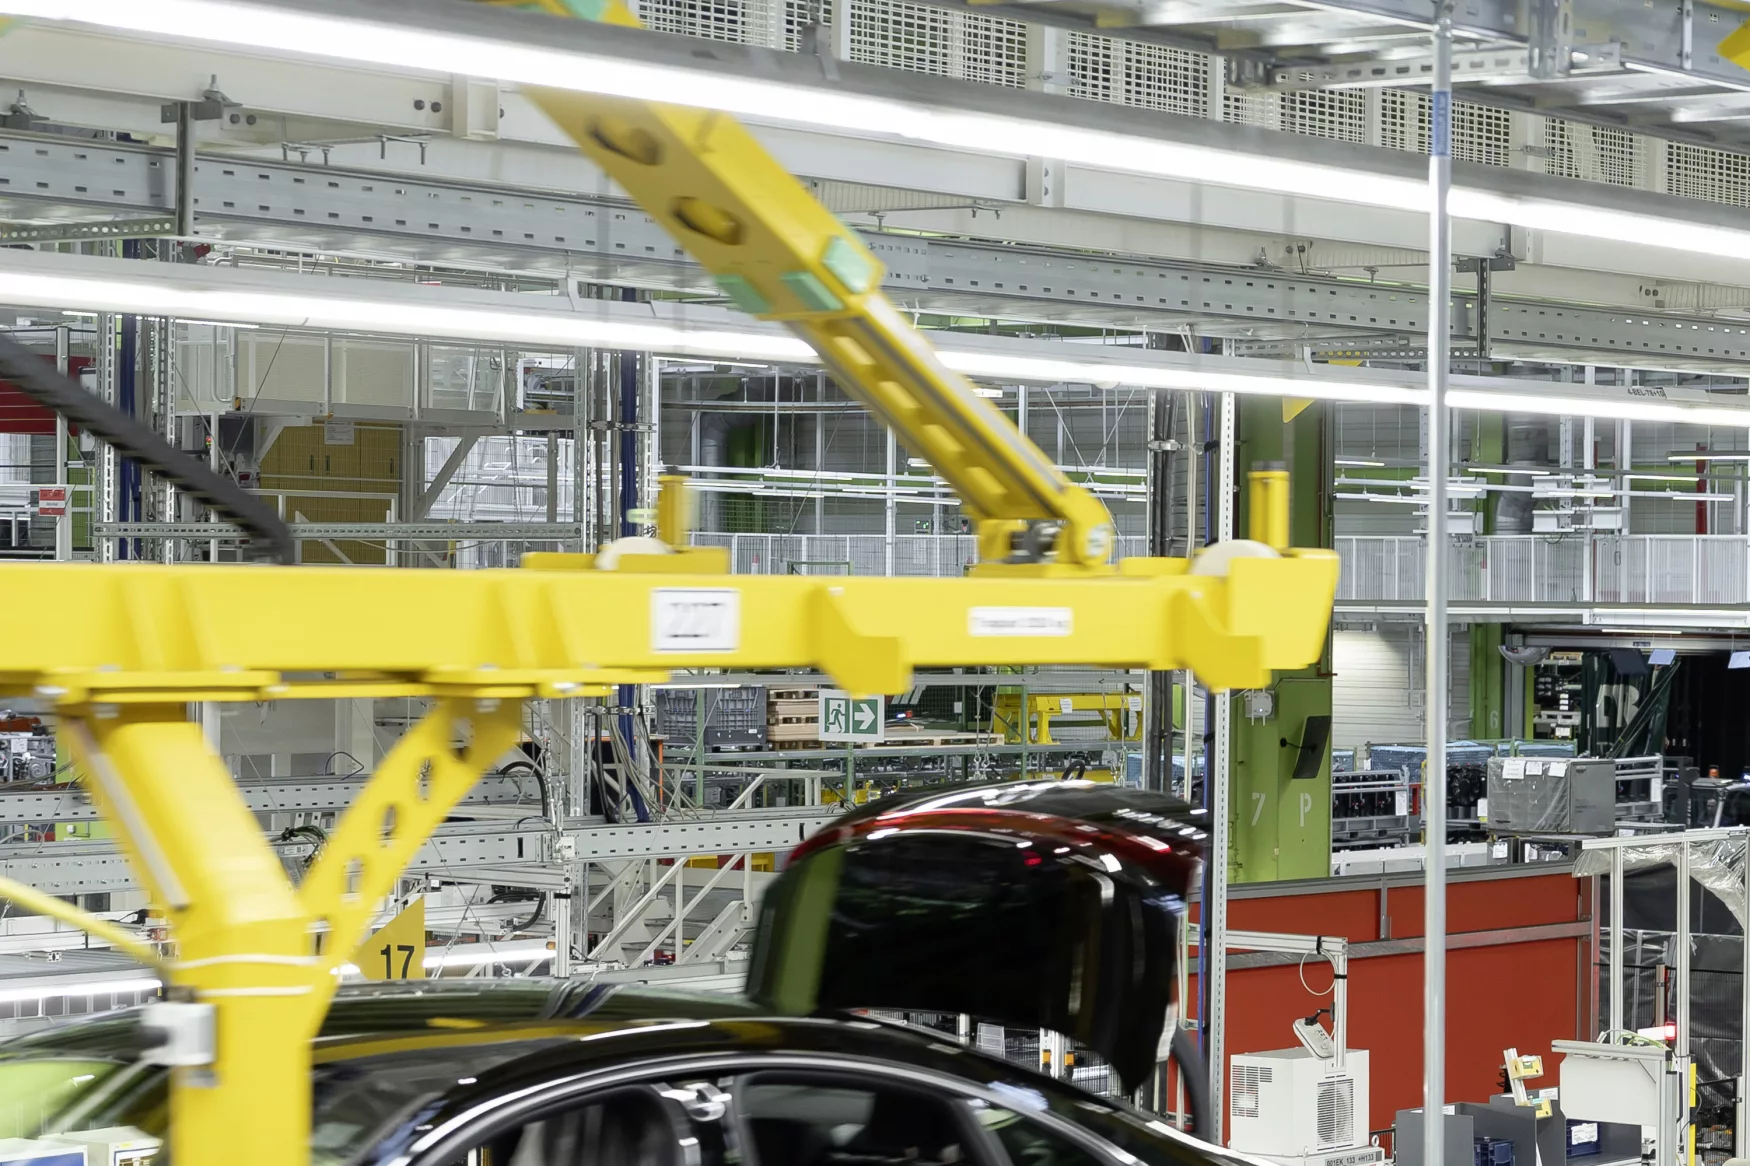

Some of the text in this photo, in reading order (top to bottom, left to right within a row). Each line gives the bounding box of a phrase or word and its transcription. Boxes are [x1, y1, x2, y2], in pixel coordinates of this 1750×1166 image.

[1489, 710, 1499, 730] 6
[1251, 792, 1312, 827] 7 P
[380, 944, 415, 979] 17
